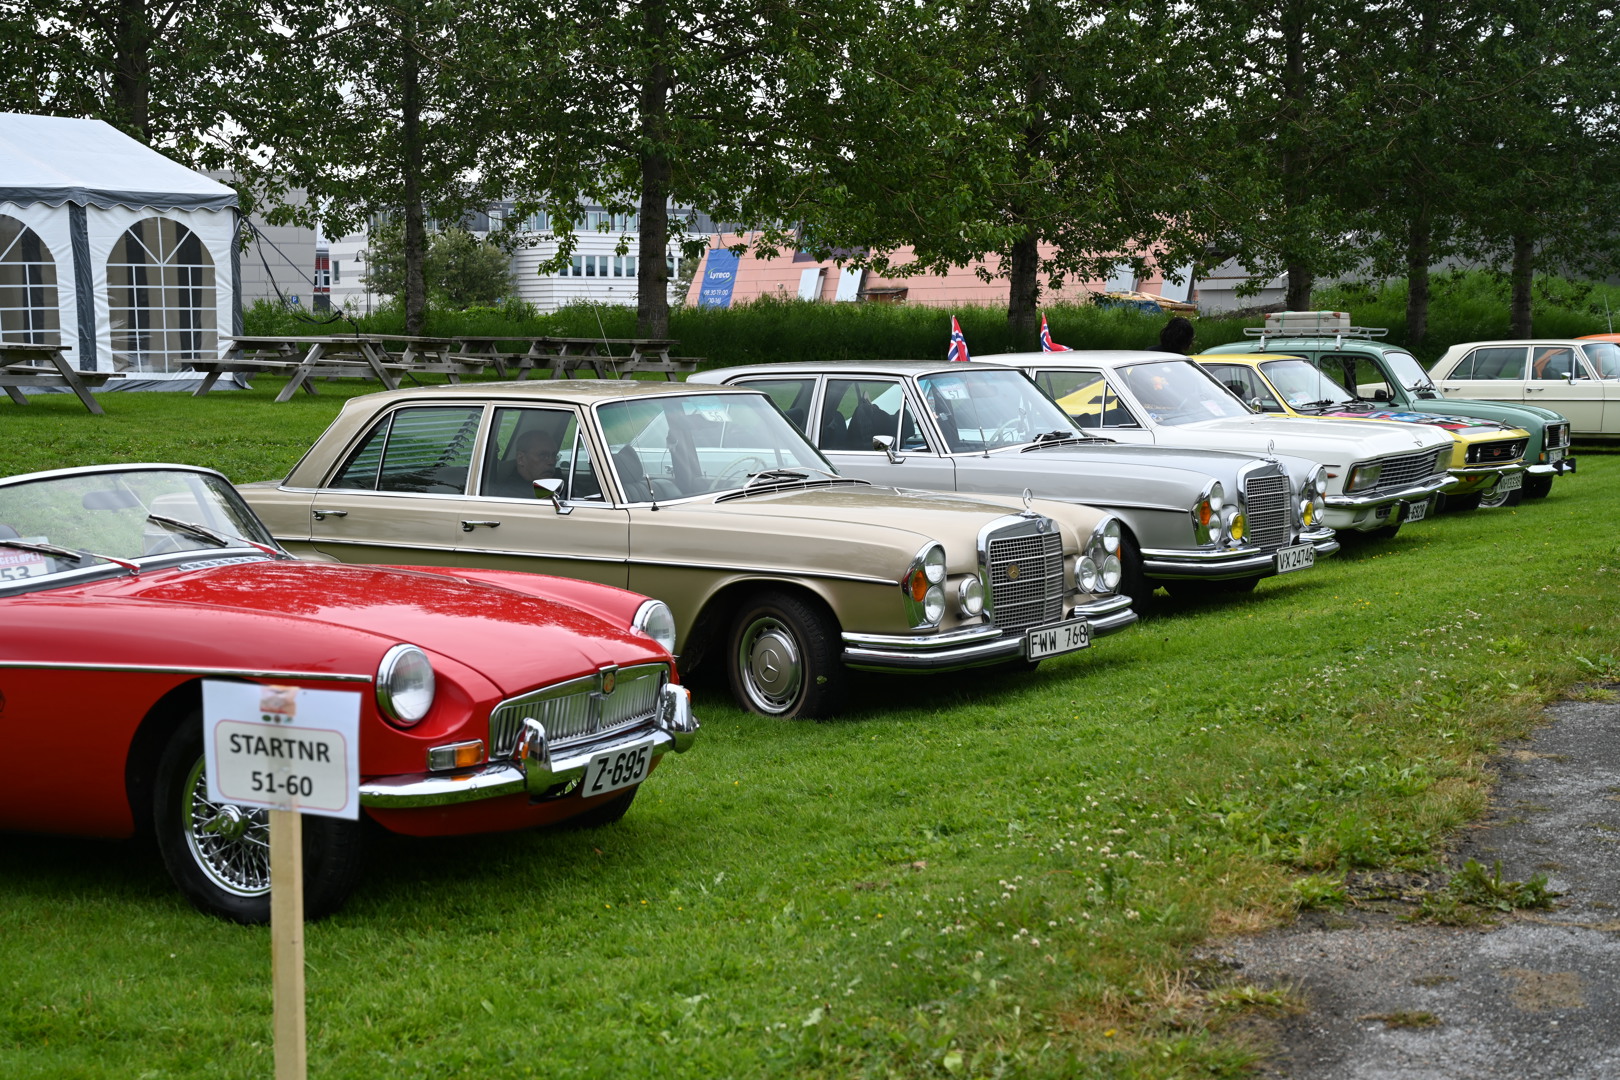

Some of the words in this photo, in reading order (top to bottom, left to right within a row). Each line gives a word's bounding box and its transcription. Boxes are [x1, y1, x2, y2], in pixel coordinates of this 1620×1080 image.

[709, 271, 731, 280] Lyreco
[1292, 546, 1314, 567] 24746
[0, 566, 31, 580] 53
[1031, 630, 1057, 655] FWW
[1064, 624, 1088, 647] 768
[229, 733, 331, 764] STARTNR
[591, 745, 649, 793] Z-695
[251, 770, 313, 798] 51-60
